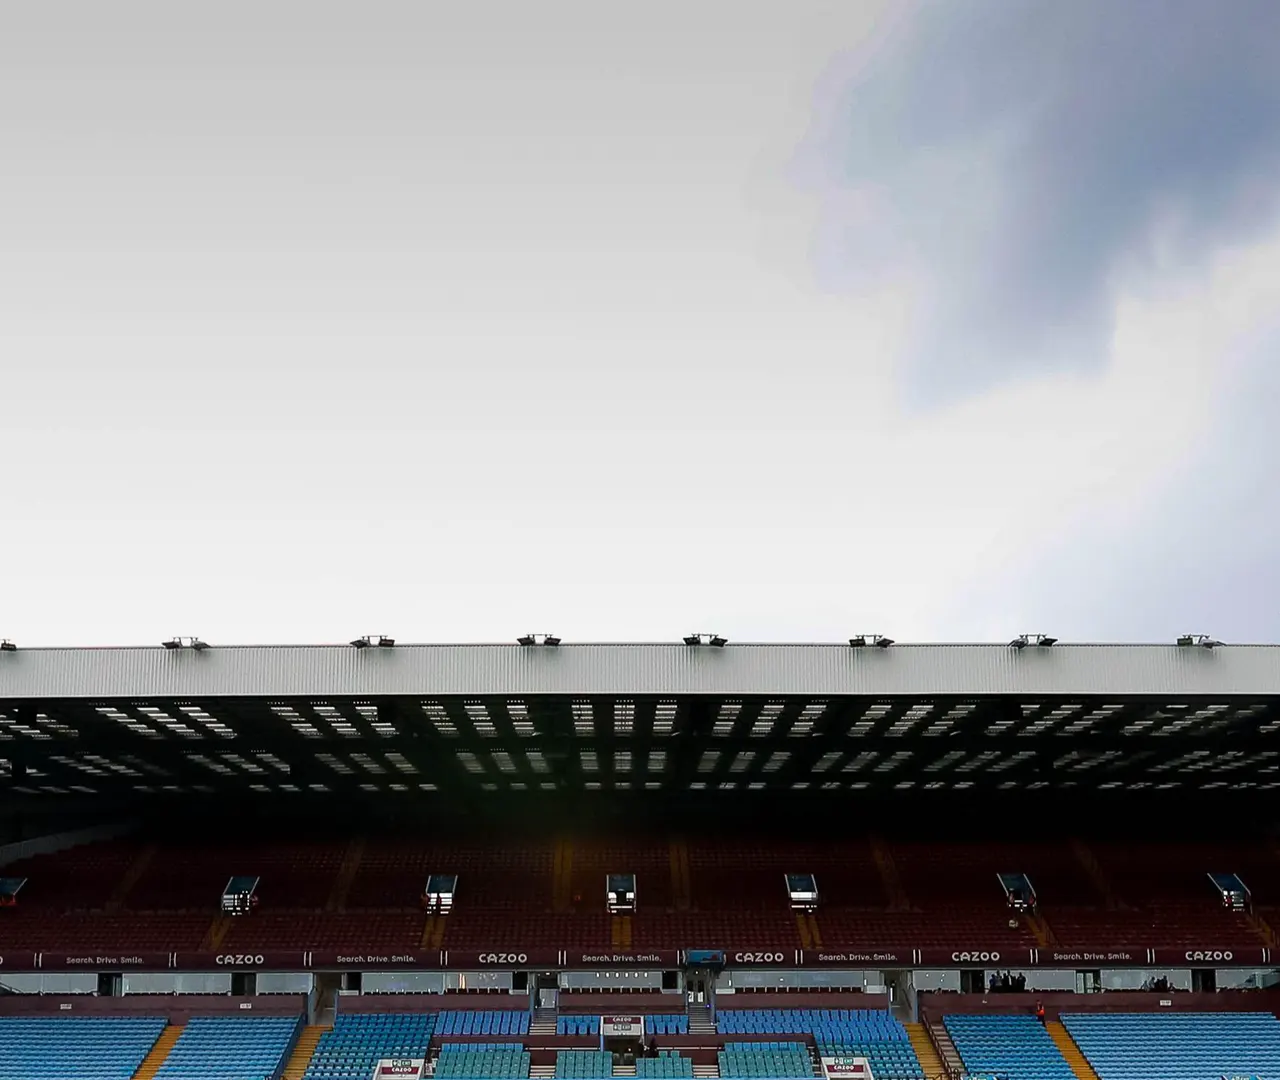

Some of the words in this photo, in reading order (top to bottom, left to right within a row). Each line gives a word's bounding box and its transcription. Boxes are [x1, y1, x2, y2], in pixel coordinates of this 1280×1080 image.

[216, 955, 264, 965] CAZOO
[478, 953, 527, 963] CAZOO
[735, 953, 784, 963] CAZOO
[951, 952, 1000, 962] CAZOO
[1185, 951, 1233, 961] CAZOO
